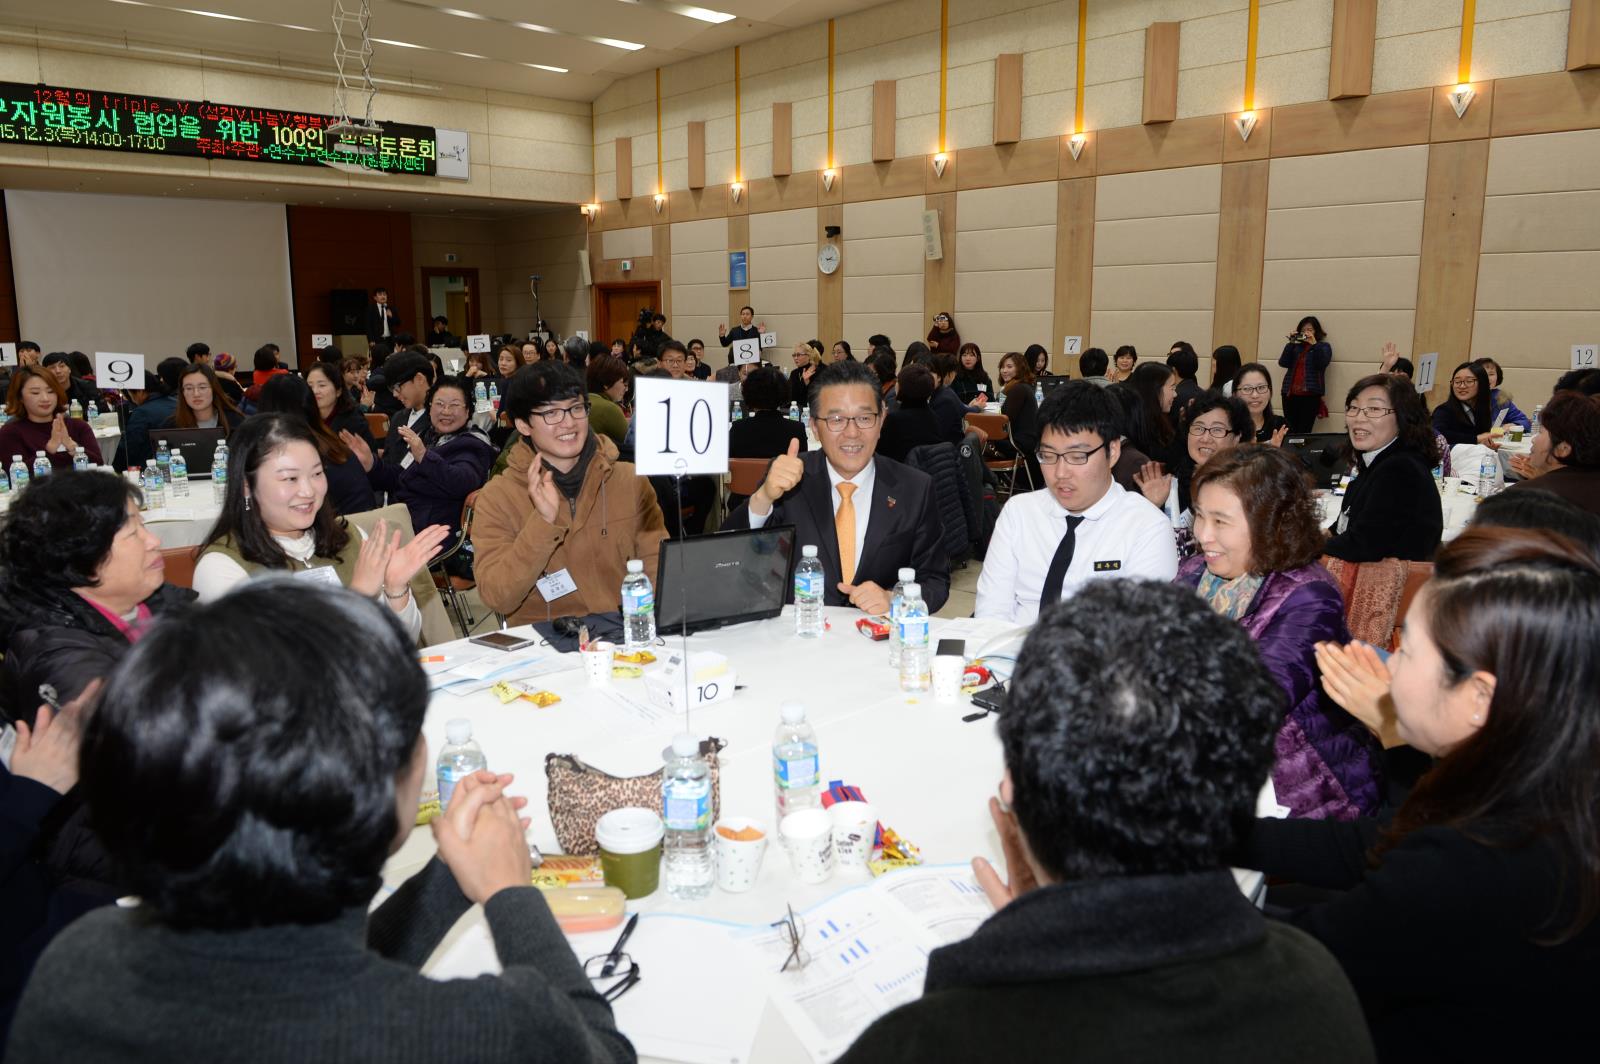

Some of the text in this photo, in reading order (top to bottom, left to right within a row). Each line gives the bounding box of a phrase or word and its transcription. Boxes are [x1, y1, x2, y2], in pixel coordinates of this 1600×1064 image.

[132, 111, 202, 139] 협업을
[215, 118, 262, 144] 위한
[272, 126, 324, 151] 100인
[316, 336, 329, 347] 2
[473, 337, 486, 350] 5
[764, 334, 774, 346] 6
[1068, 338, 1078, 351] 7
[739, 343, 754, 360] 8
[1575, 349, 1593, 365] 12
[107, 359, 133, 383] 9
[1418, 360, 1432, 386] 11
[657, 396, 712, 455] 10
[697, 682, 719, 703] 10
